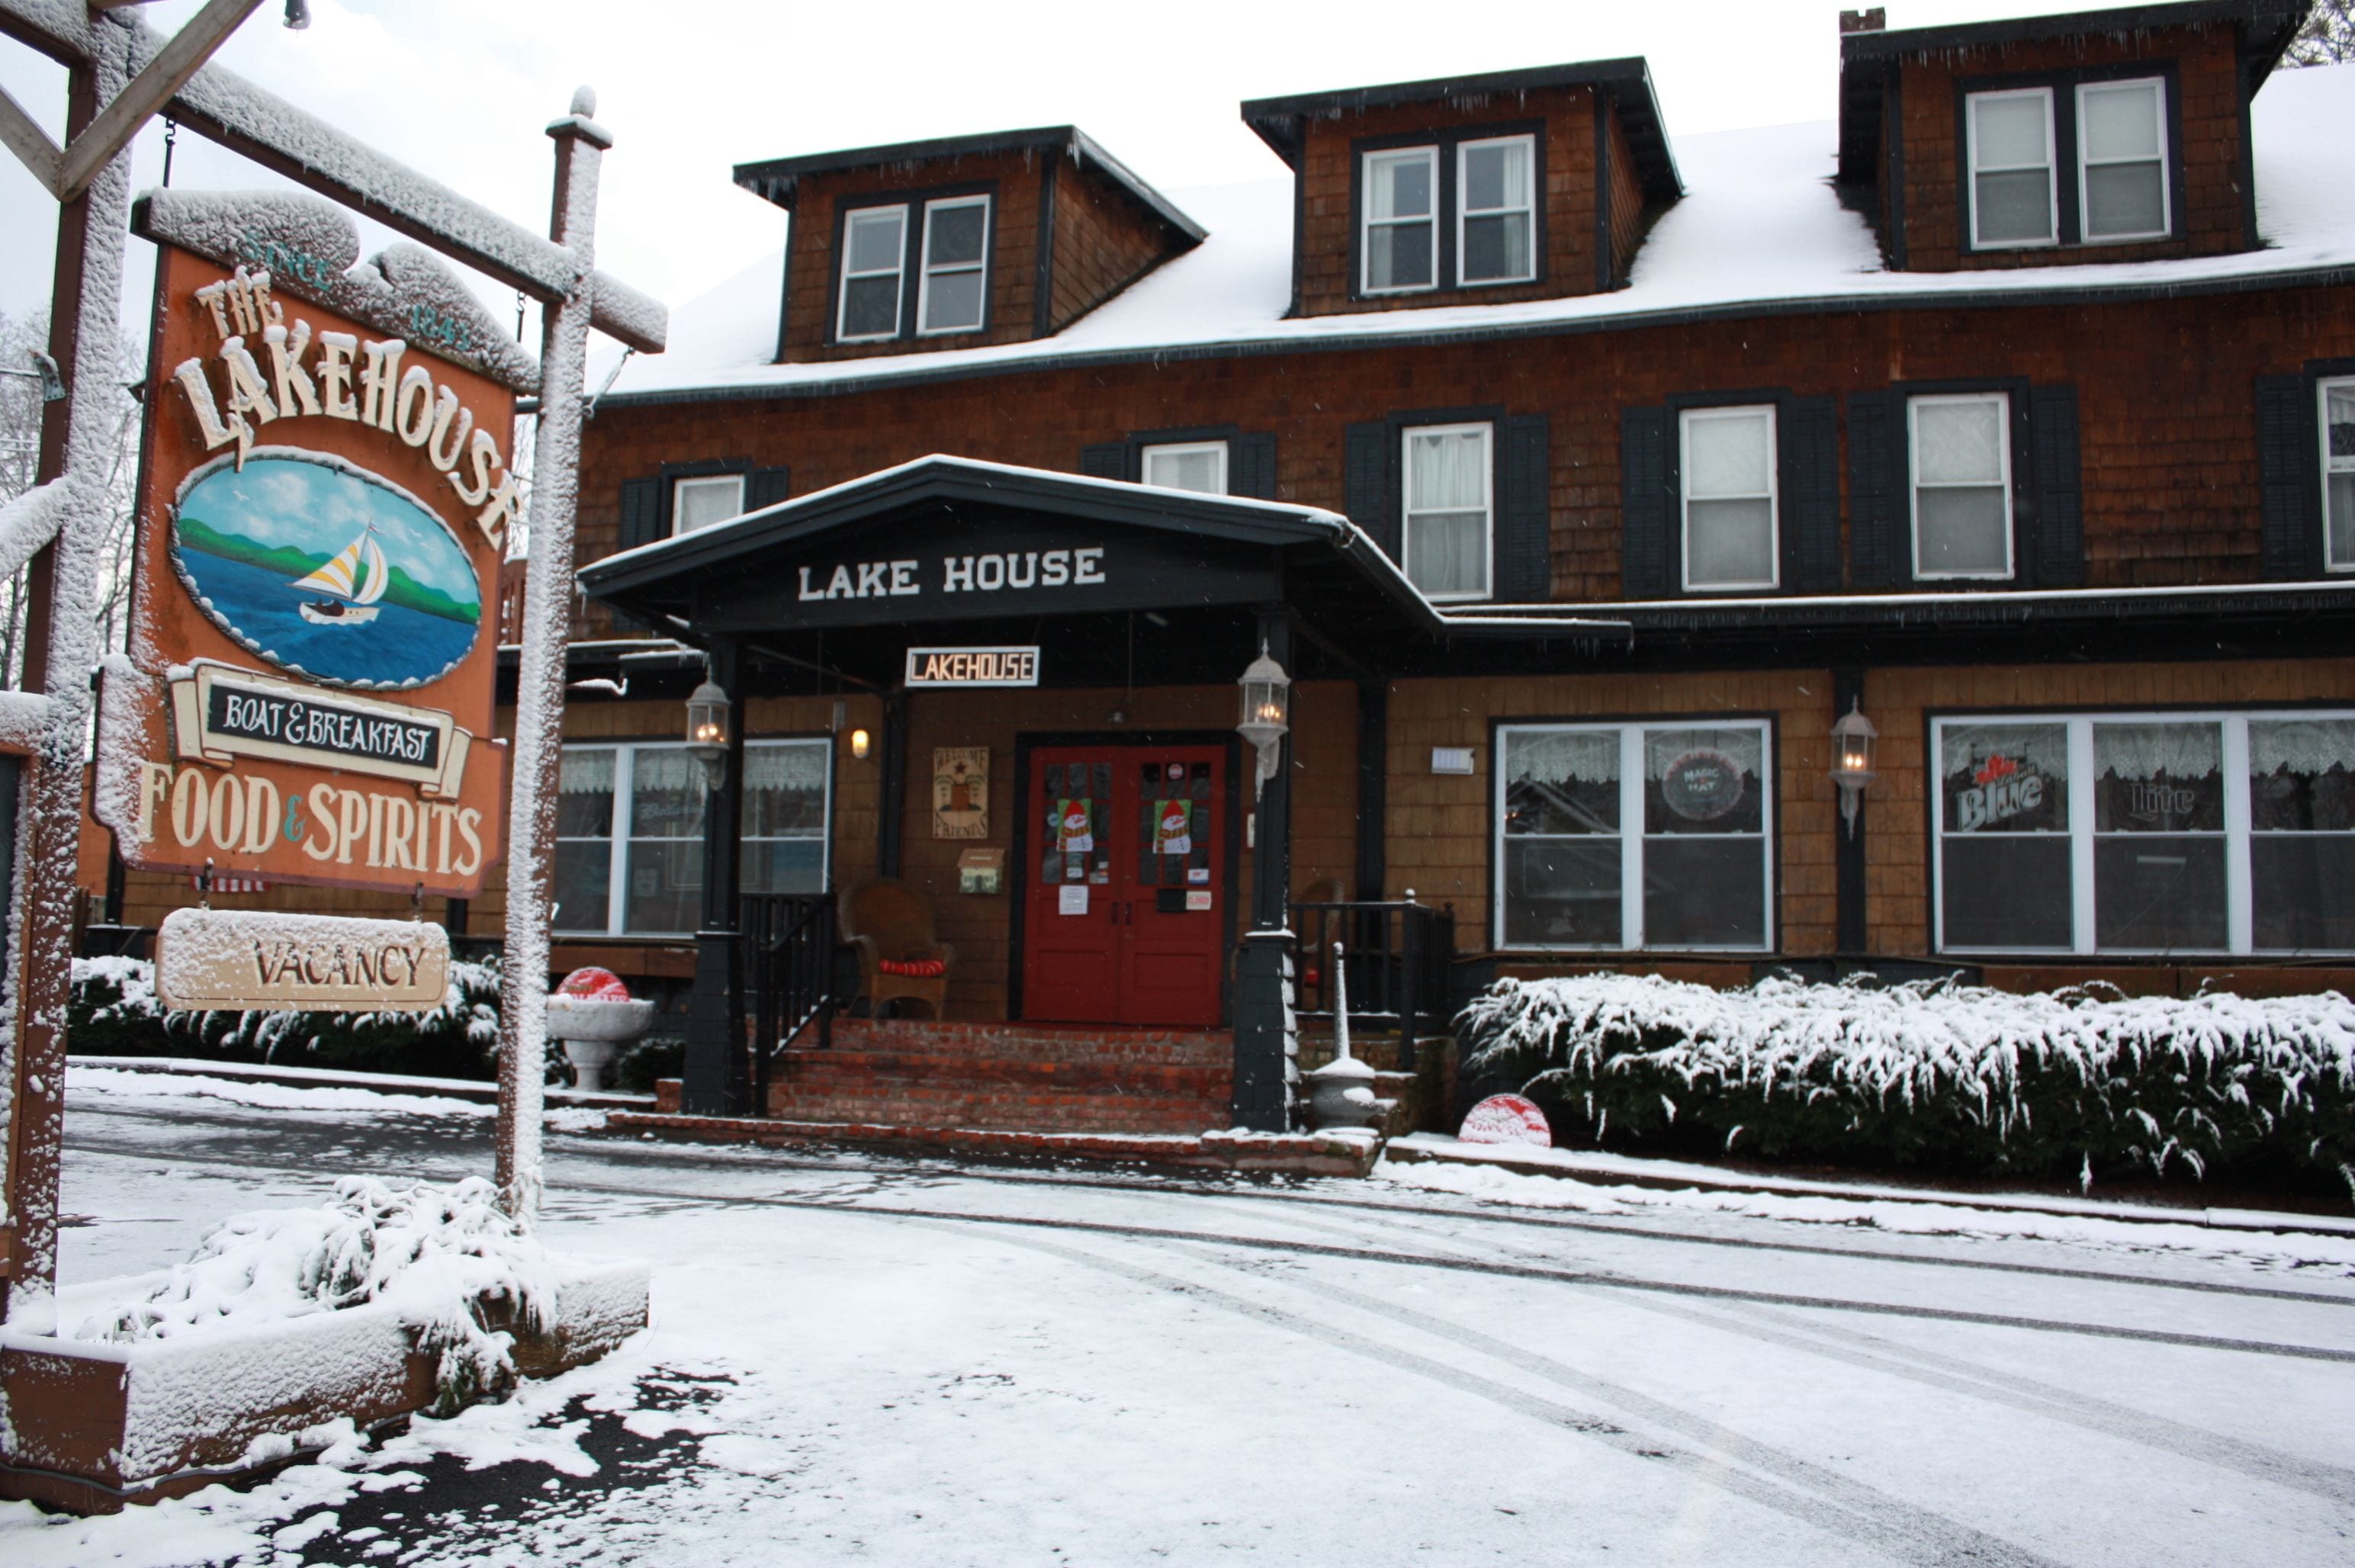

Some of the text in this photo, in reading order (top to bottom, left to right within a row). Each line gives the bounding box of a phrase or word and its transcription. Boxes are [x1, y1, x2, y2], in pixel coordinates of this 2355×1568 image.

[196, 268, 282, 339] THE
[175, 321, 525, 551] LAKEHOUSE
[798, 548, 1106, 601] LAKE HOUSE
[911, 653, 1034, 681] LAKEHOUSE
[223, 694, 432, 761] BOAT & BREAKFAST
[934, 749, 988, 772] WELCOME
[1684, 768, 1720, 783] MAGIC
[1688, 781, 1716, 792] HAT
[1956, 775, 2043, 831] Blue
[139, 761, 482, 876] FOOD & SPIRITS
[933, 808, 988, 837] FRIENDS
[255, 940, 426, 988] VACANCY
